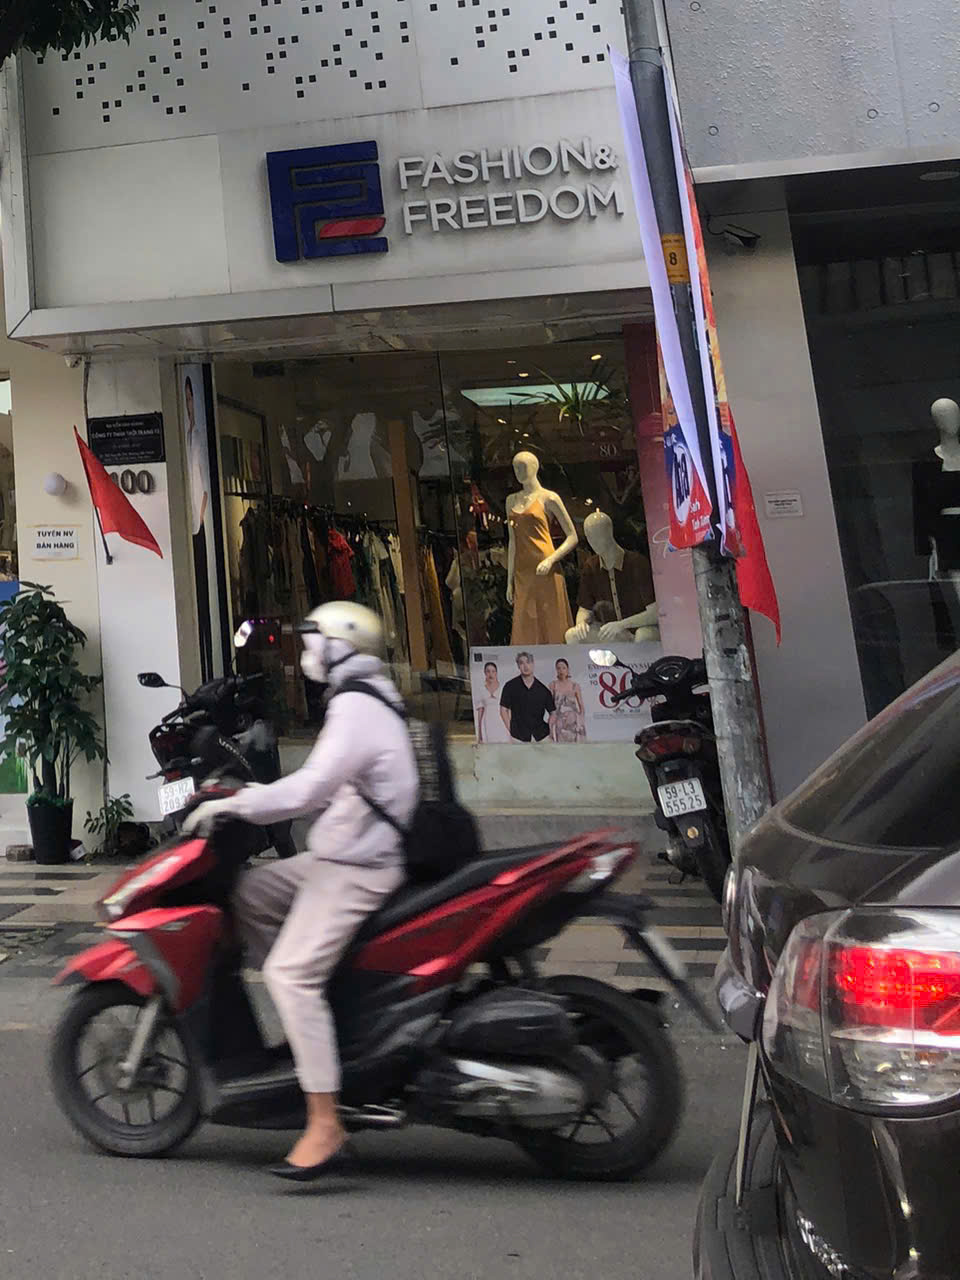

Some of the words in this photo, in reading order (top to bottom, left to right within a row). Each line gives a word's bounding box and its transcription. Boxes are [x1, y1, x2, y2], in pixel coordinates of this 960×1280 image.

[401, 181, 625, 235] FREEDOM
[669, 252, 678, 266] 8
[665, 782, 696, 800] 59-L3
[665, 795, 703, 814] 555.25
